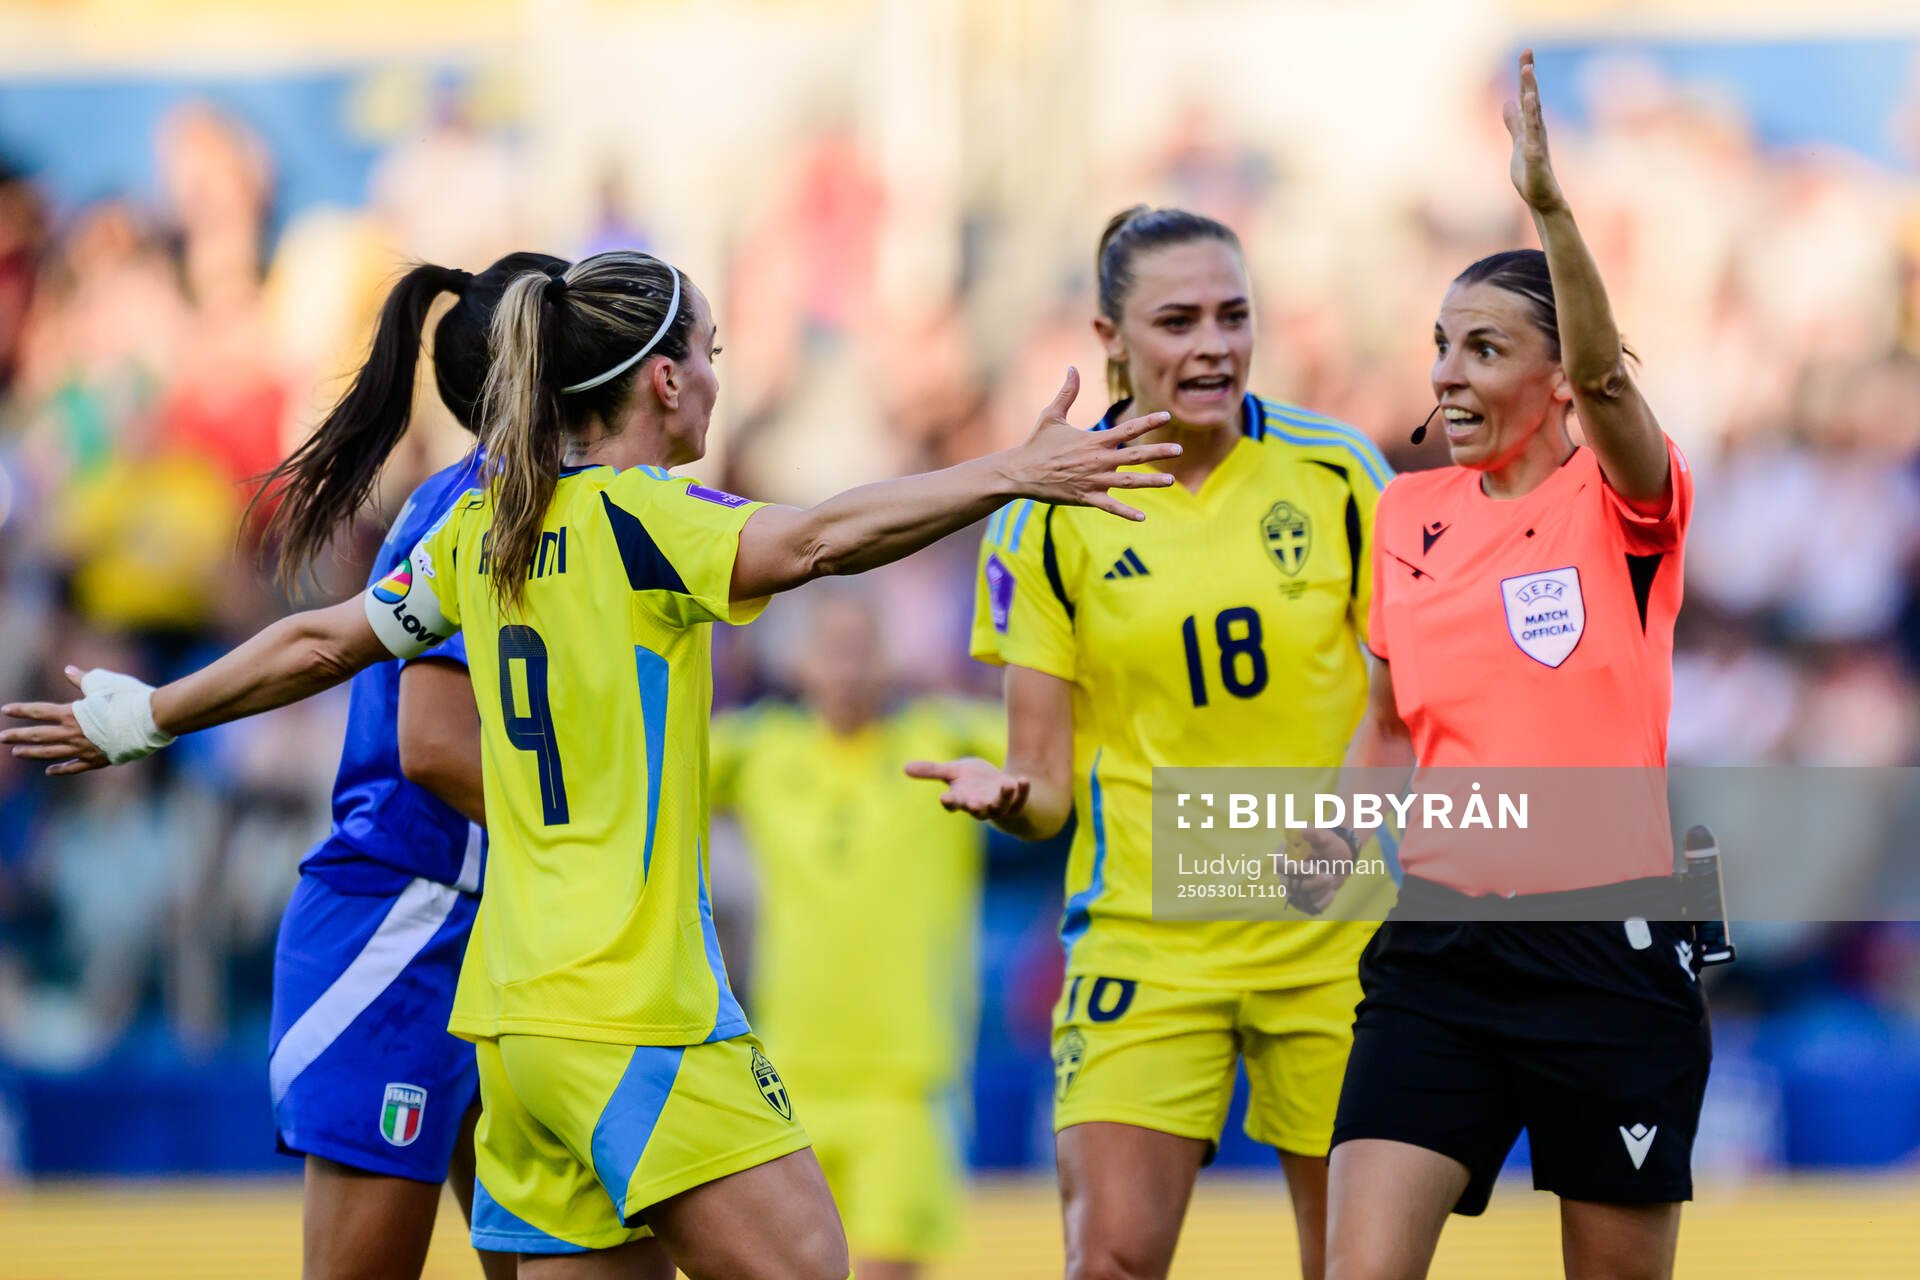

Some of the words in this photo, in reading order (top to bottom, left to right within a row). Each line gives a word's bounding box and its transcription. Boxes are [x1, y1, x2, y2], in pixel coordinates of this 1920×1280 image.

[1518, 583, 1563, 602] UEFA
[1525, 610, 1568, 626] MATCH
[1522, 623, 1576, 641] OFFICIAL
[1182, 605, 1269, 709] 18
[499, 624, 570, 827] 9
